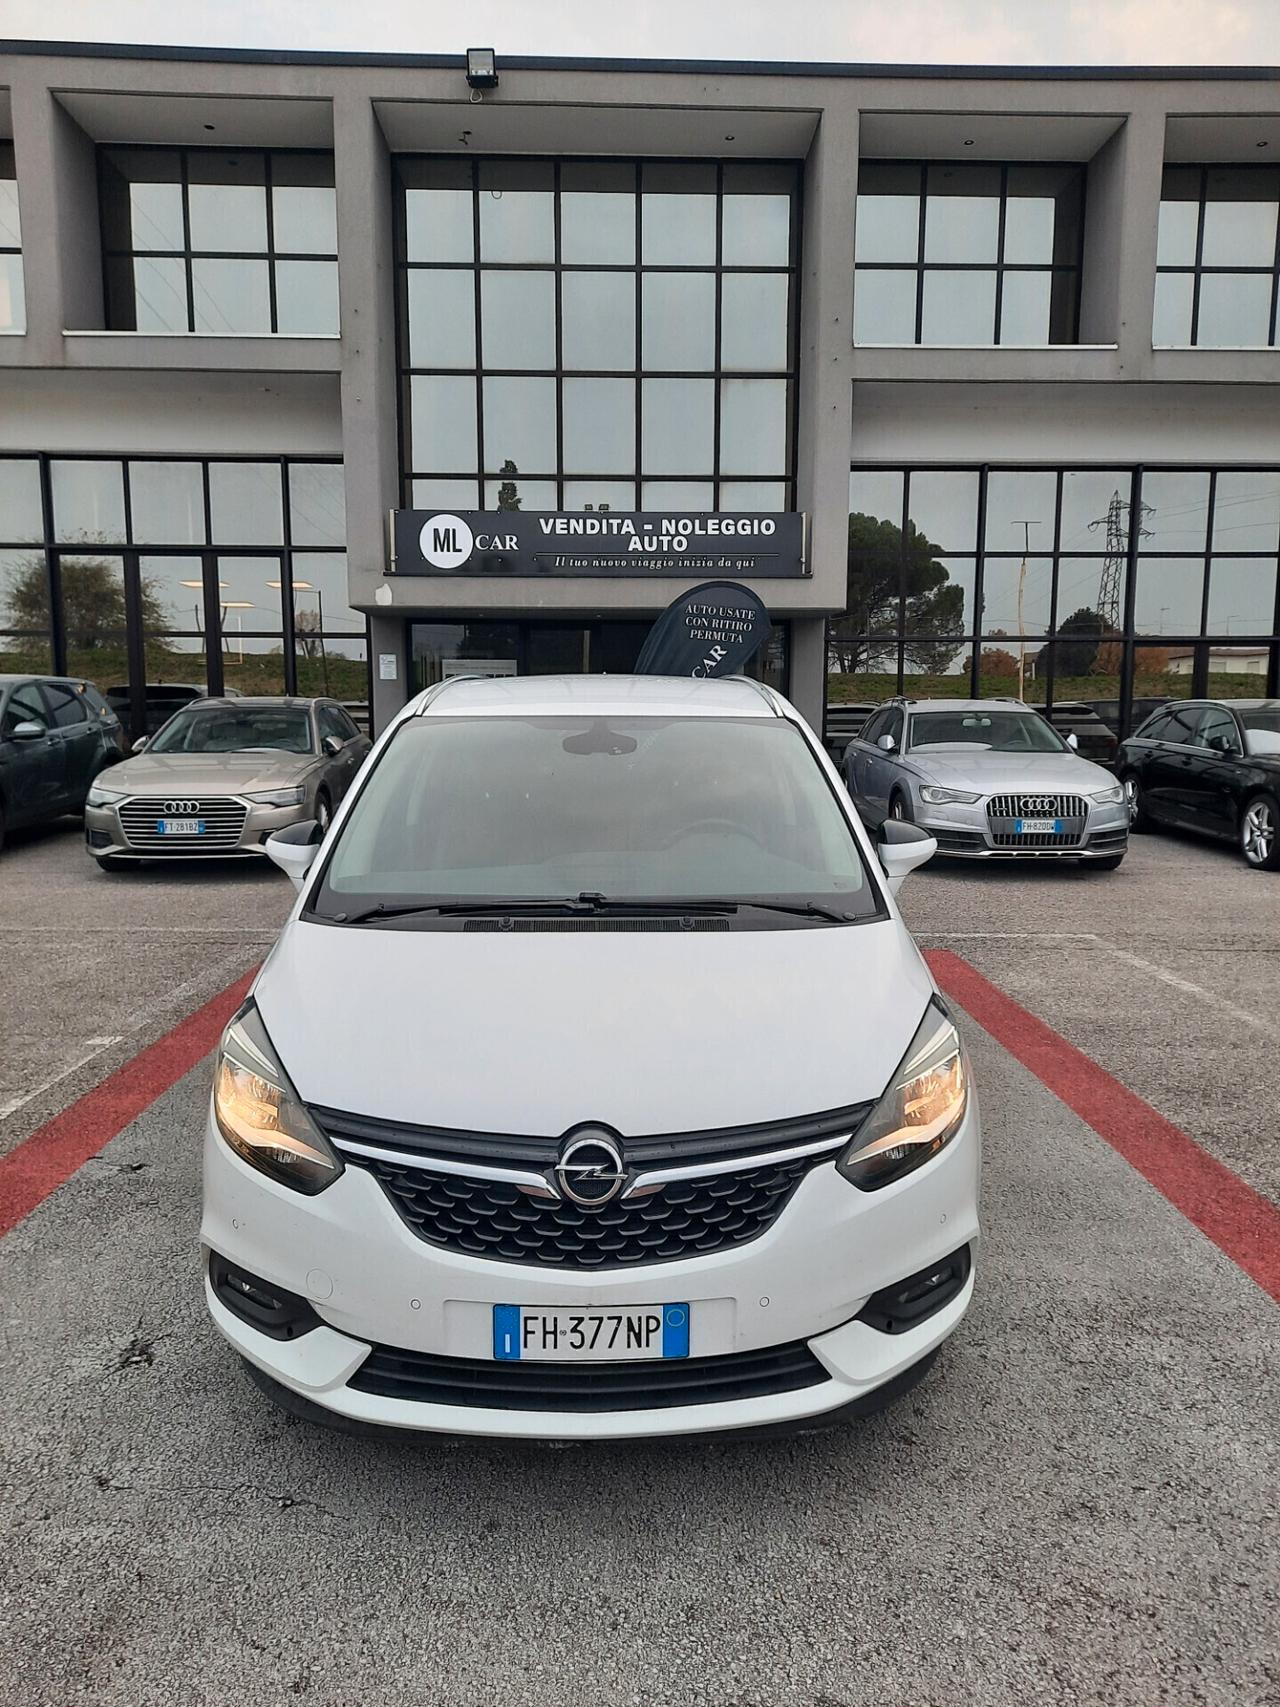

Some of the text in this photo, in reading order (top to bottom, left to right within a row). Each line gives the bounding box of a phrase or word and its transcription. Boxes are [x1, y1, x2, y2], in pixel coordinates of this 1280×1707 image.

[539, 518, 635, 535] VENDITA
[661, 519, 776, 535] NOLEGGIO
[433, 528, 519, 552] ML CAR
[628, 536, 688, 551] AUTO
[555, 557, 755, 570] Il tuo nuovo viaggio inizia da qui
[685, 604, 756, 620] AUTO USATE
[685, 616, 752, 632] CON RITIRO
[690, 629, 743, 643] PERMUTA
[691, 645, 728, 678] CAR
